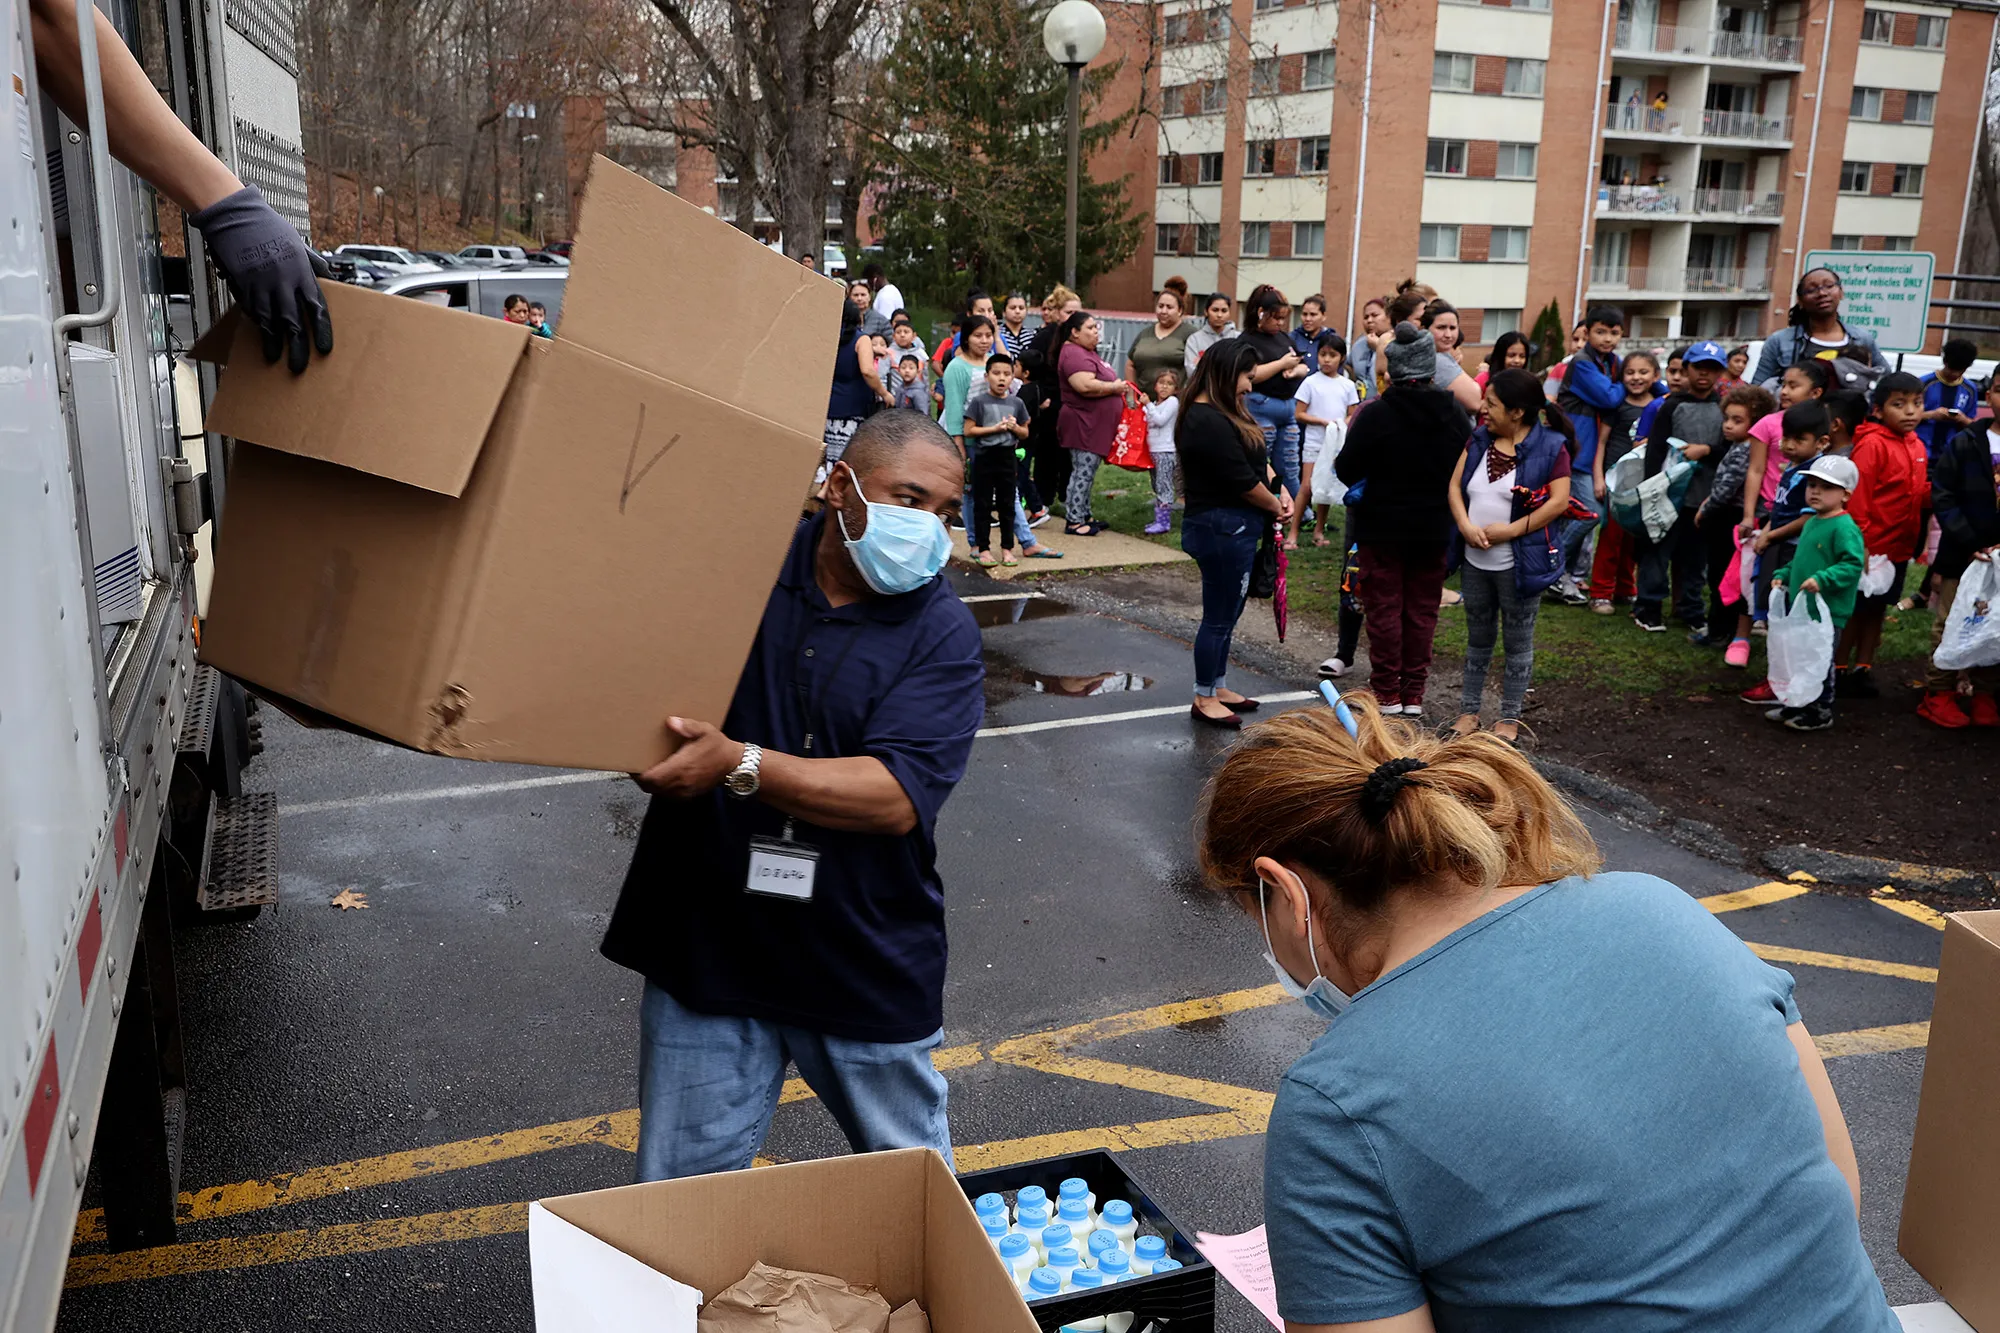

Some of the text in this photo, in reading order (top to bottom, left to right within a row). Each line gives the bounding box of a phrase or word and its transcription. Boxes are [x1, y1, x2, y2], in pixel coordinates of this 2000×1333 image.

[1854, 263, 1864, 273] for
[1868, 263, 1913, 274] Commercial
[1869, 278, 1900, 288] vehicles
[1903, 278, 1923, 288] ONLY
[1873, 317, 1891, 327] WILL
[1820, 456, 1837, 470] NY
